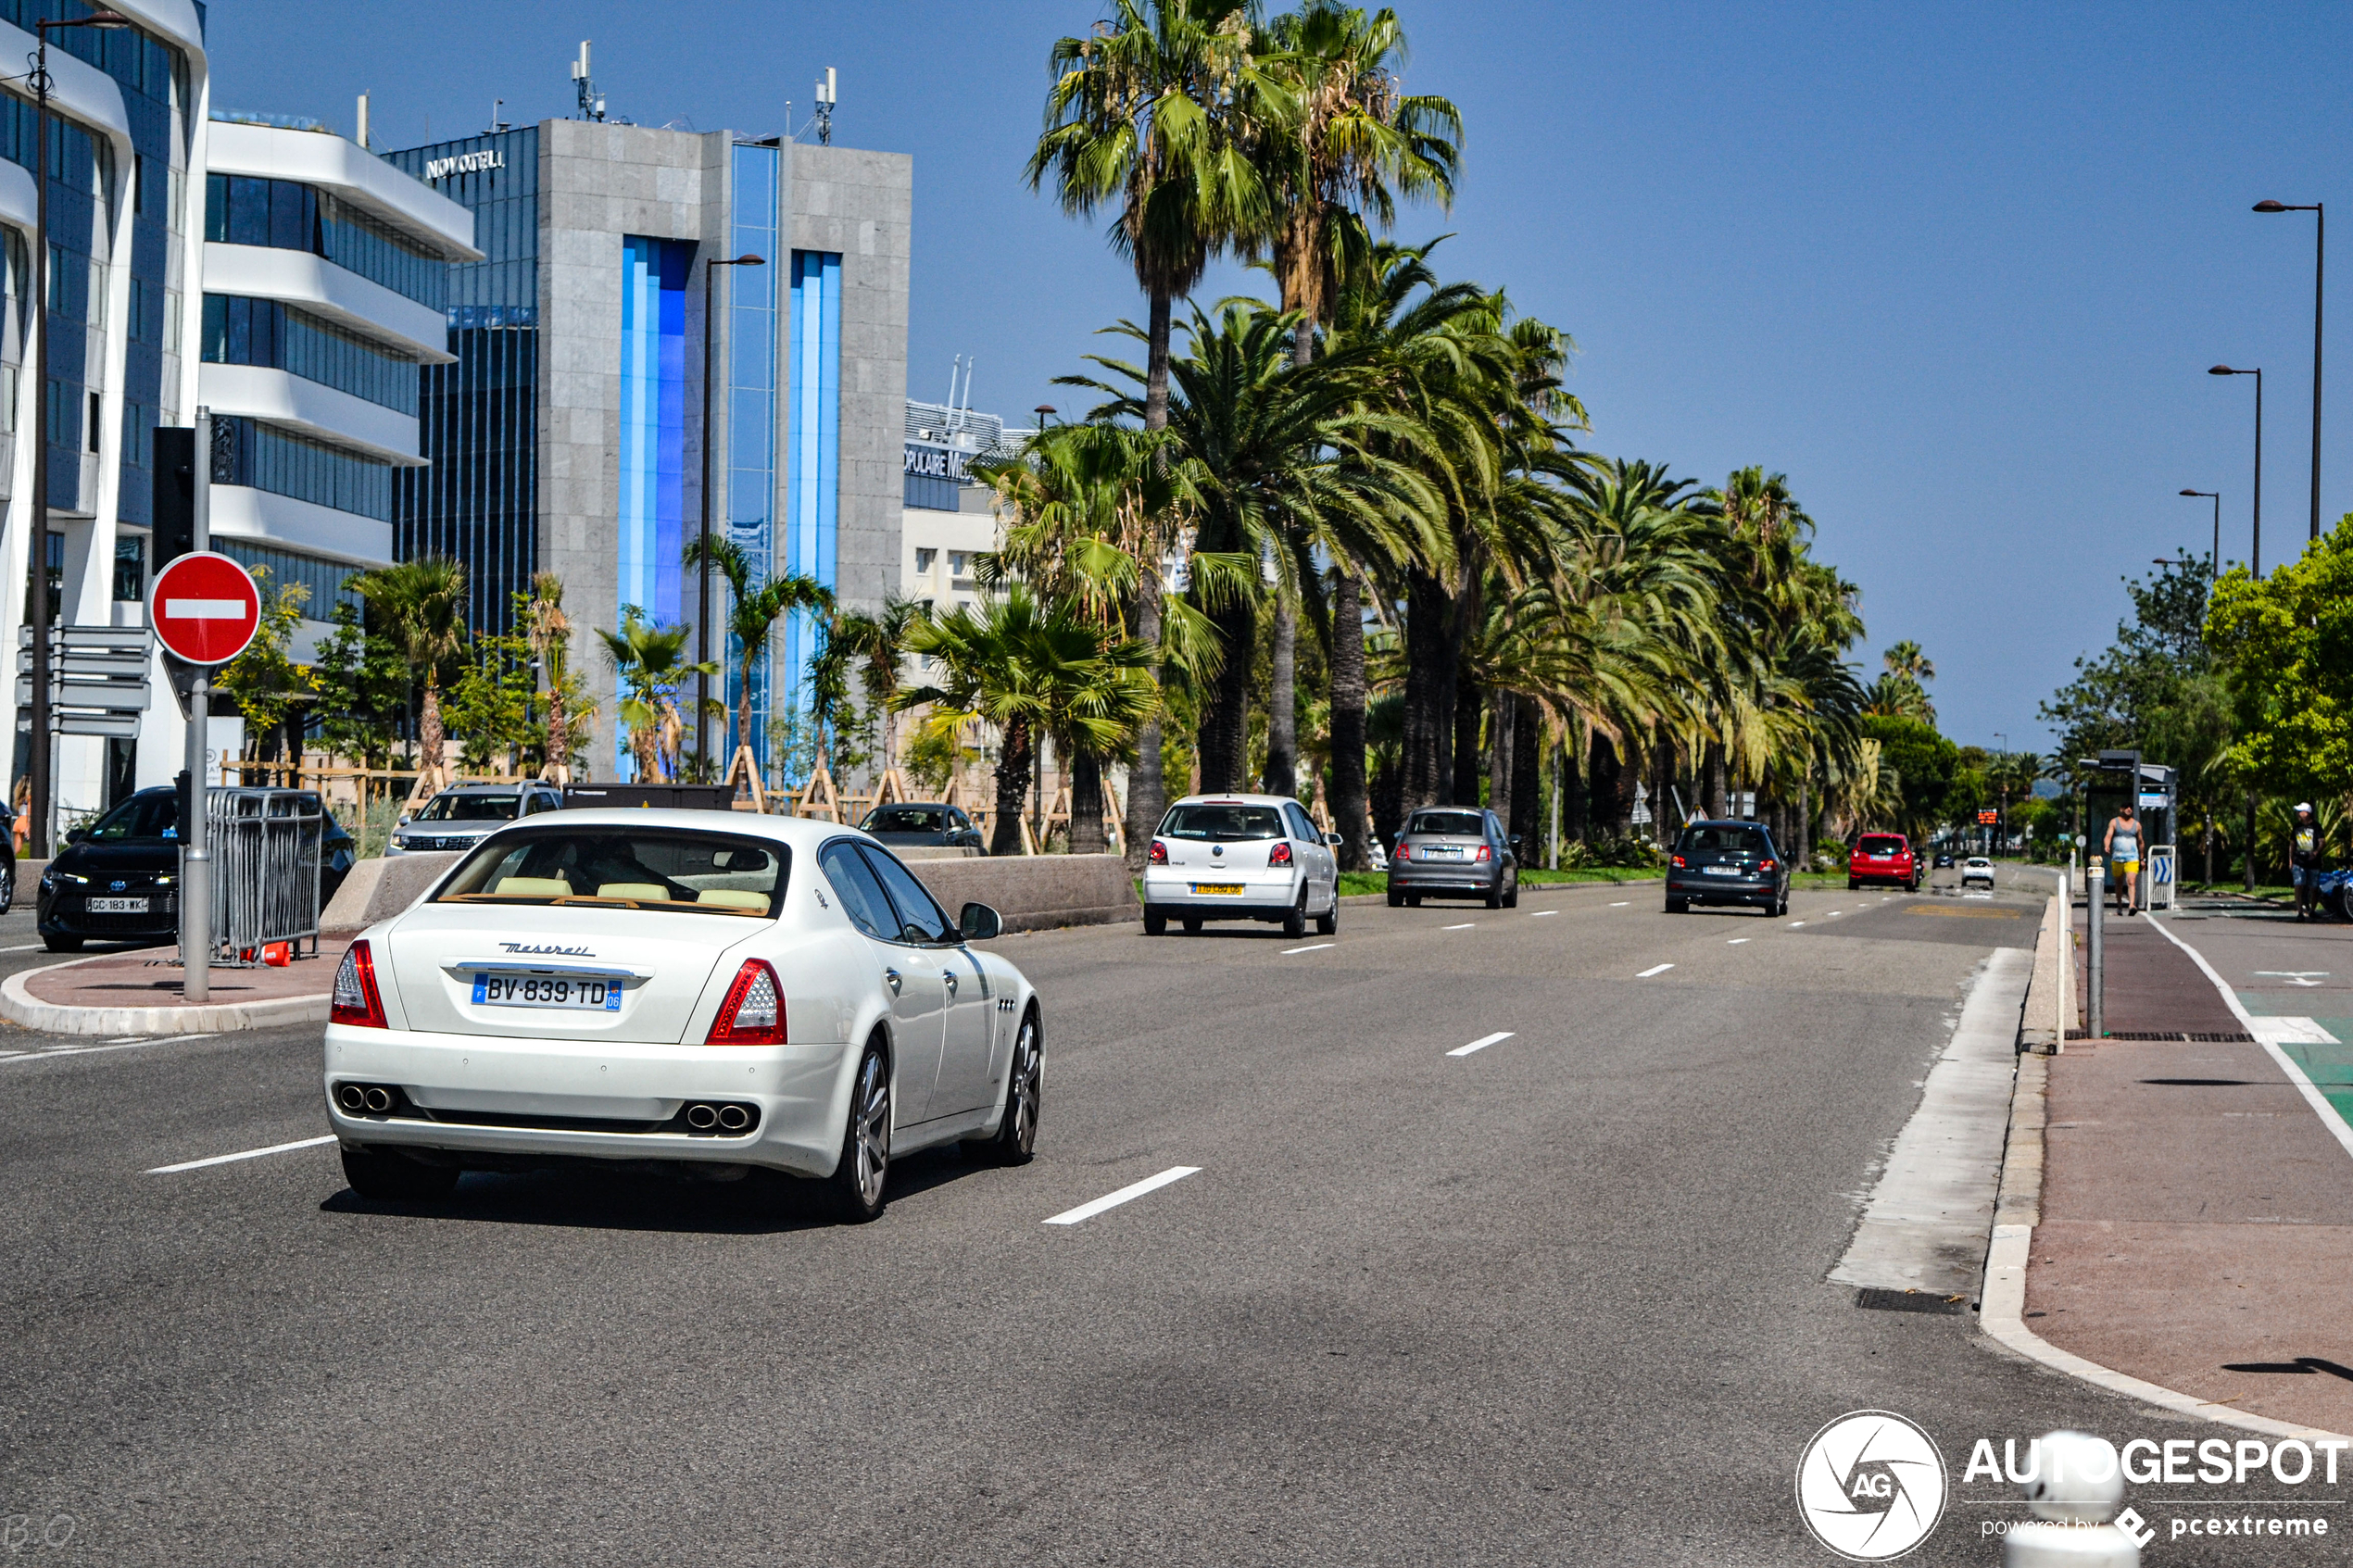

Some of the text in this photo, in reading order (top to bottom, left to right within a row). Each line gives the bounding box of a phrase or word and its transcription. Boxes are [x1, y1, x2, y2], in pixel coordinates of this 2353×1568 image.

[426, 150, 497, 179] NOVOTEL
[93, 899, 142, 909] GC-183-WK
[498, 942, 597, 958] Maserati
[487, 978, 606, 1004] BV-839-TD
[608, 997, 619, 1007] 06
